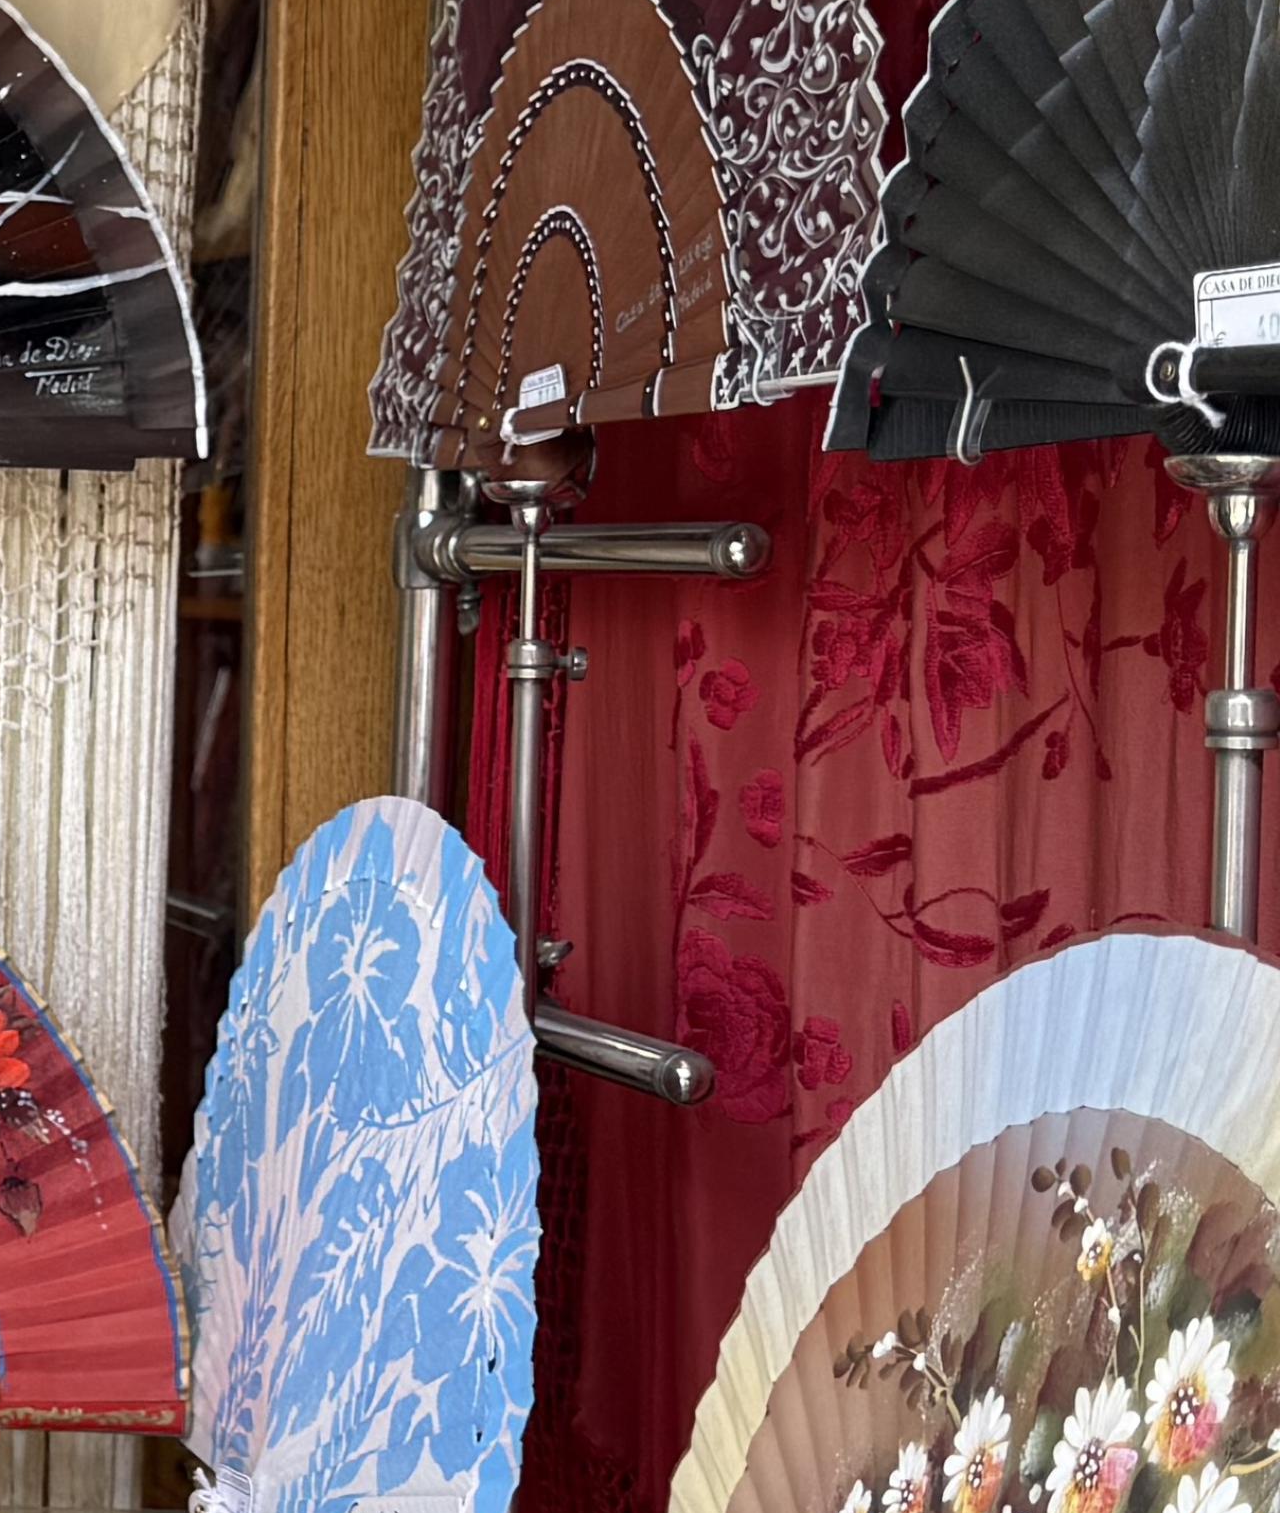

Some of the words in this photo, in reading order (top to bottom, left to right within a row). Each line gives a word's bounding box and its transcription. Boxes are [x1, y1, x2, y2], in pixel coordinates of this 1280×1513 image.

[1203, 279, 1236, 296] CASA
[1239, 276, 1252, 292] DE
[19, 341, 41, 365] de
[35, 373, 95, 396] Madrid
